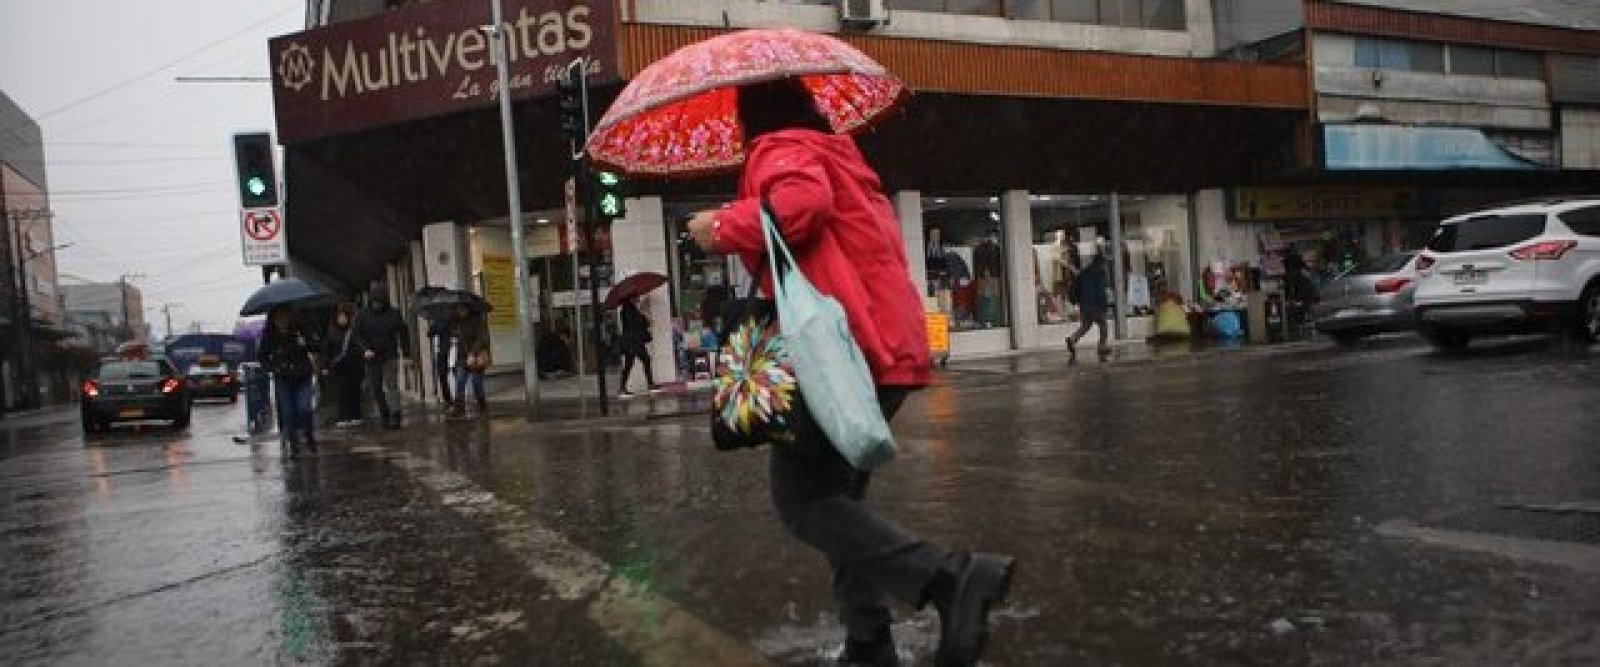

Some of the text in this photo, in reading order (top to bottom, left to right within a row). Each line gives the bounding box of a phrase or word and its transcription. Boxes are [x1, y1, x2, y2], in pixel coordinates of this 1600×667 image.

[321, 4, 593, 101] Multiventas
[452, 75, 481, 98] La
[489, 74, 532, 100] gan
